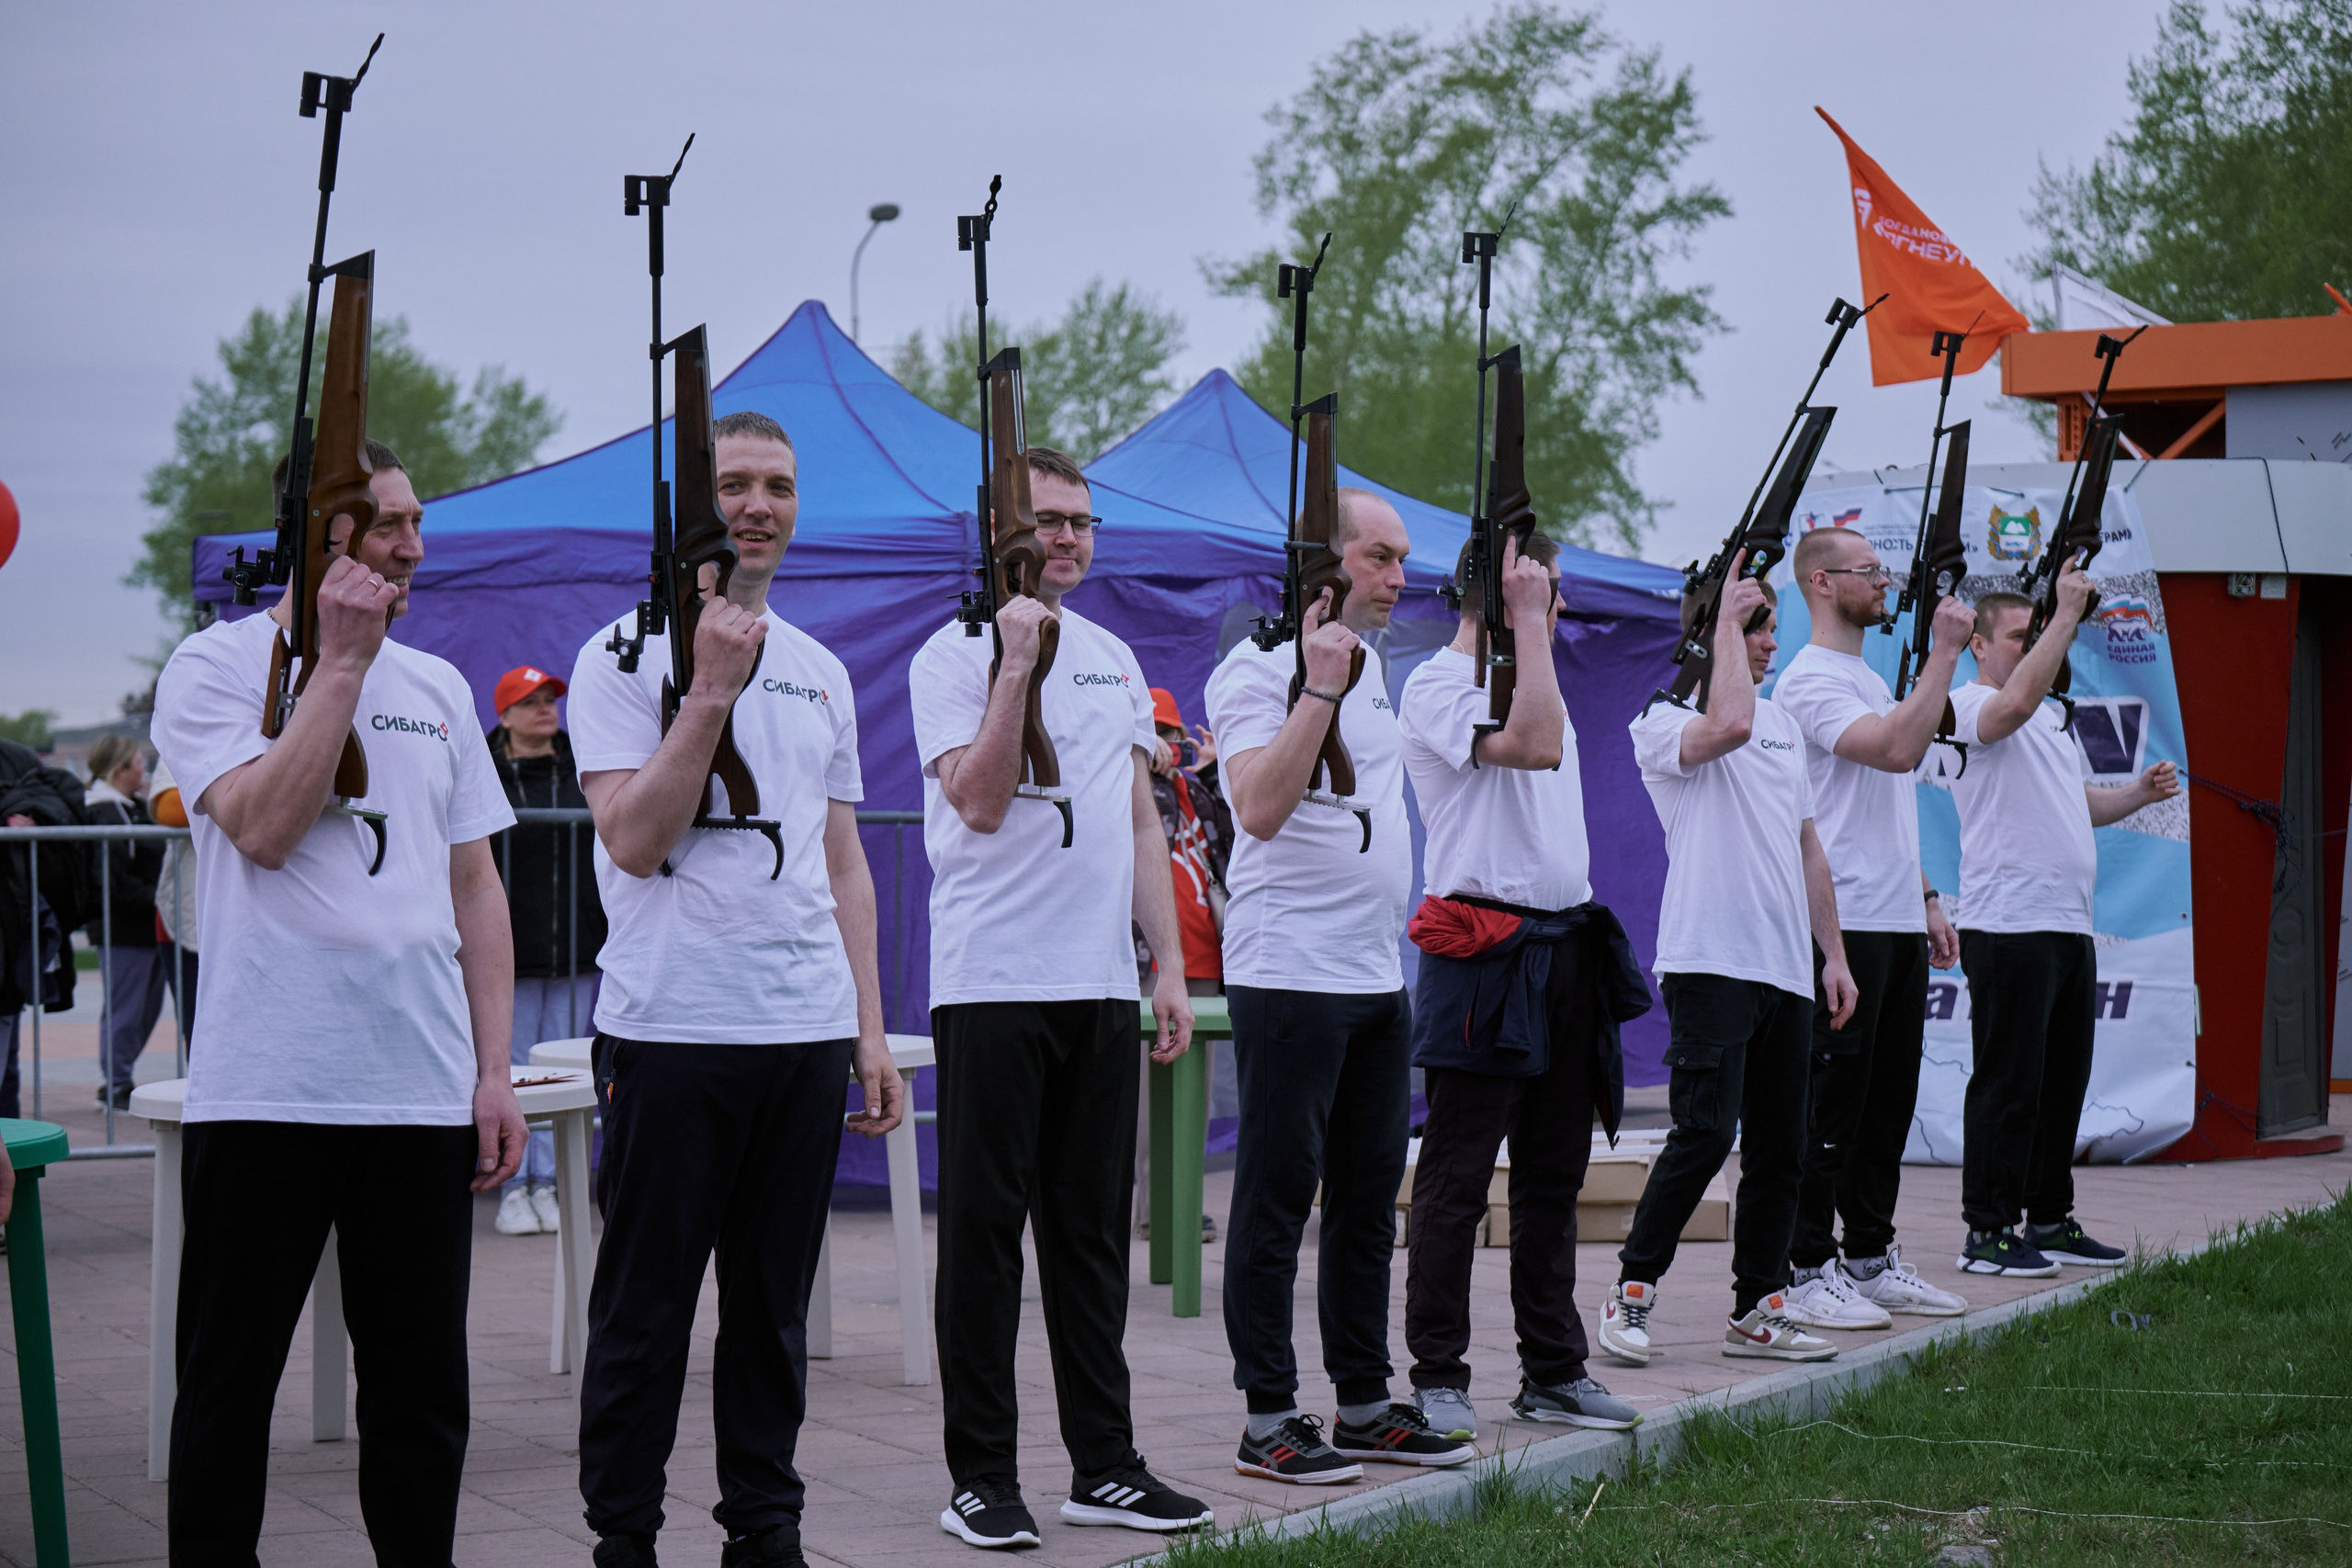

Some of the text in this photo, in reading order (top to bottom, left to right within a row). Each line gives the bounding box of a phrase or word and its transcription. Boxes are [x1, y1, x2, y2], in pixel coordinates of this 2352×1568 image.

[1878, 215, 1954, 245] БОГДАНОВ
[2107, 643, 2155, 653] ЕДИНАЯ
[2109, 652, 2156, 663] РОССИЯ
[371, 714, 448, 742] СИБАГРО
